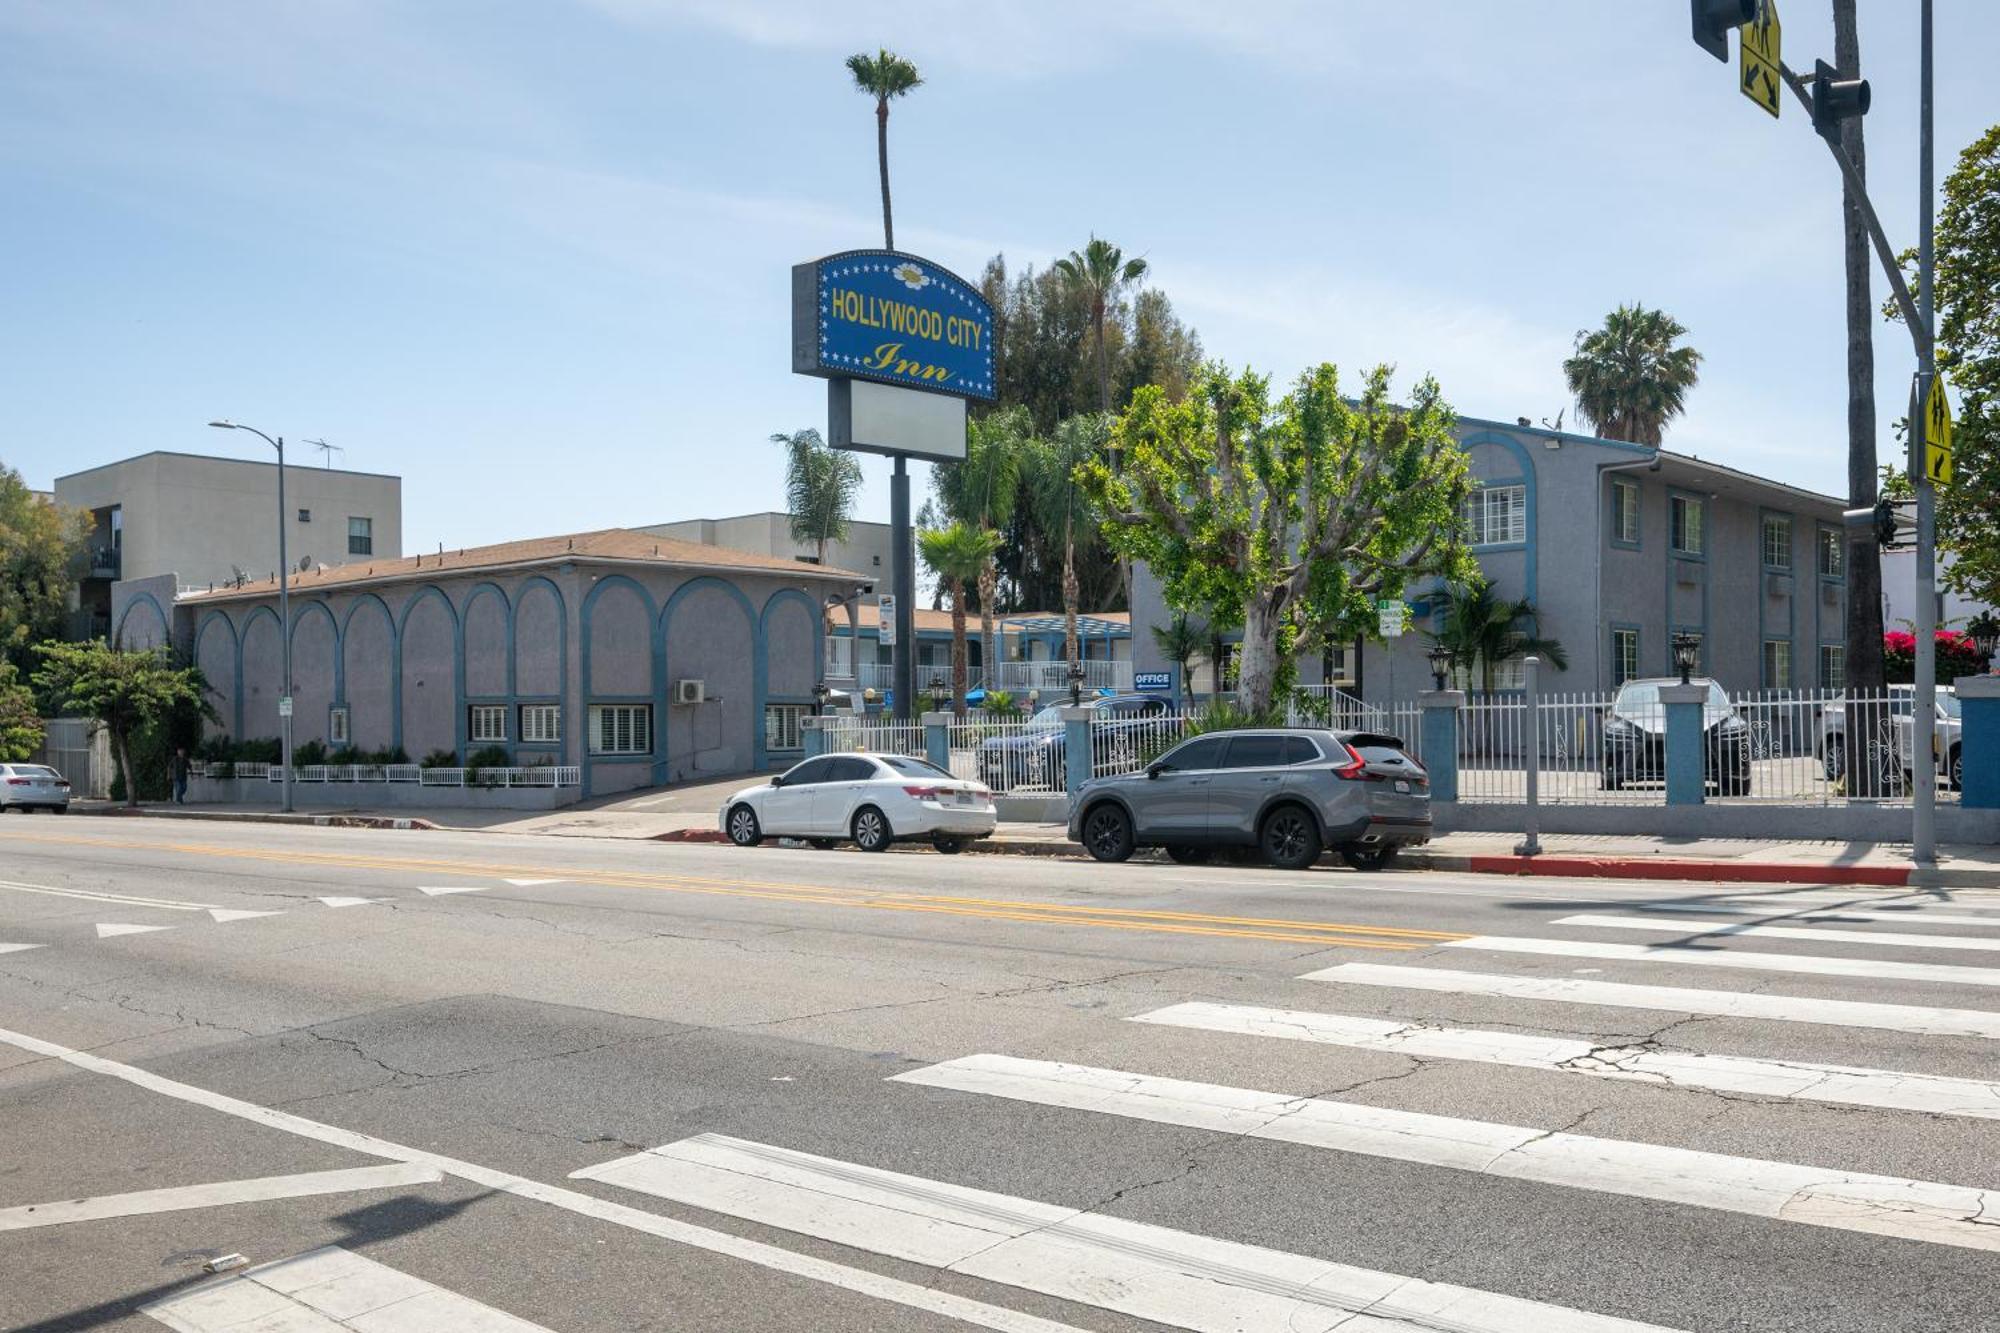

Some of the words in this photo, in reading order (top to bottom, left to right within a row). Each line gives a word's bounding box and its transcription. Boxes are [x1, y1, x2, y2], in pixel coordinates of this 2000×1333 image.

[832, 287, 943, 341] HOLLYWOOD
[947, 316, 982, 350] CITY
[863, 343, 957, 382] Inn
[1135, 674, 1169, 683] OFFICE
